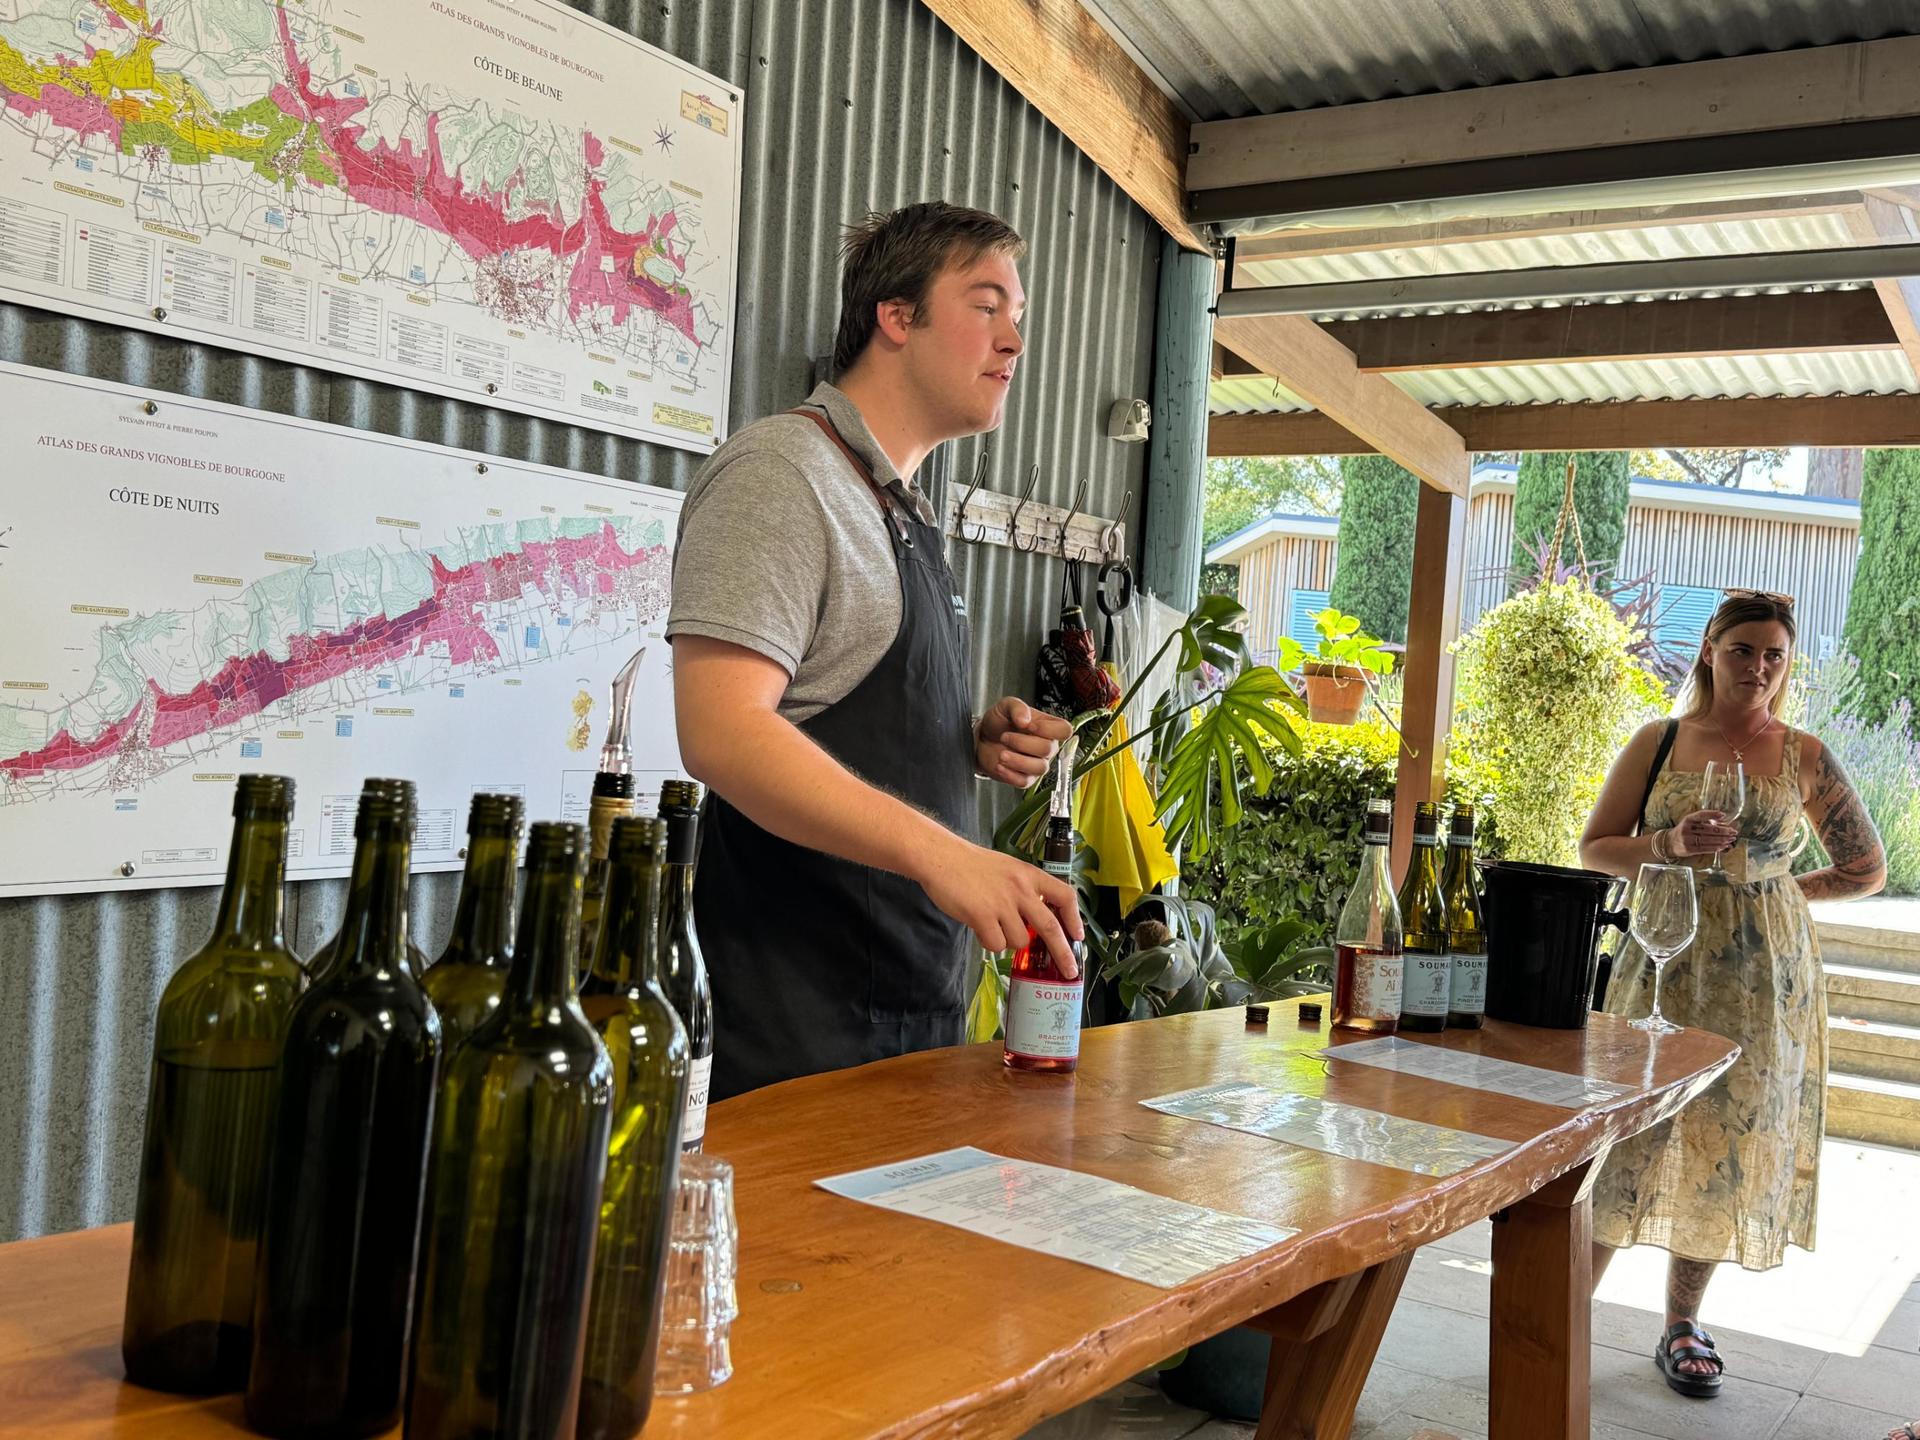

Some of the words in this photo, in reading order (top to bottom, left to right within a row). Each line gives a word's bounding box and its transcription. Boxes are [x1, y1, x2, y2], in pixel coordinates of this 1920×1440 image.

[430, 1, 456, 18] ATLAS
[457, 12, 472, 25] DES
[474, 17, 506, 40] GRANDS
[506, 32, 548, 57] VIGNOBLES
[550, 51, 560, 64] DE
[561, 56, 605, 83] BOURGOGNE
[474, 56, 502, 77] CÔTE
[504, 68, 520, 84] DE
[522, 74, 563, 102] BEAUNE
[118, 415, 144, 425] SYLVAIN
[172, 425, 193, 434] PIERRE
[194, 428, 218, 438] POUPON
[37, 435, 74, 450] ATLAS
[76, 441, 97, 453] DES
[100, 445, 145, 461] GRANDS
[148, 452, 206, 470] VIGNOBLES
[208, 462, 222, 473] DE
[224, 464, 286, 482] BOURGOGNE
[109, 486, 149, 505] CÔTE
[153, 494, 173, 509] DE
[177, 497, 220, 515] NUITS
